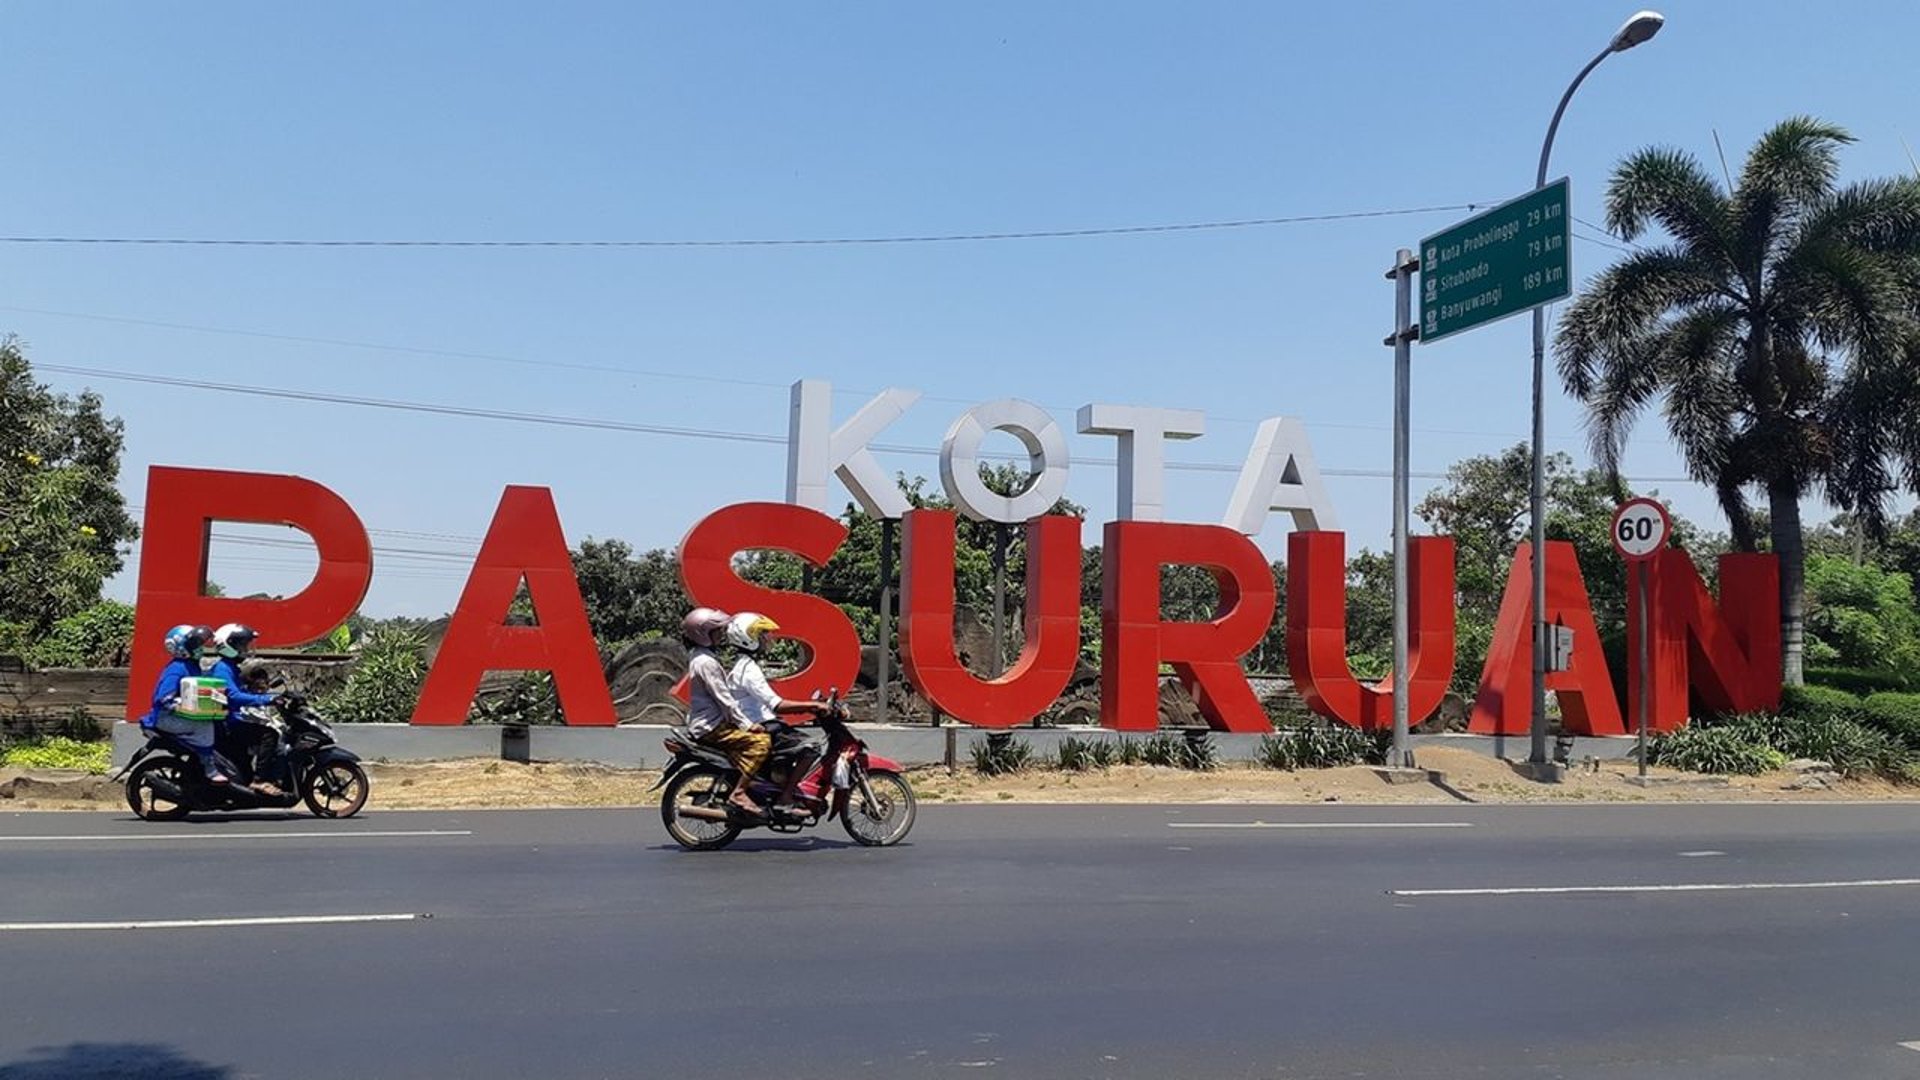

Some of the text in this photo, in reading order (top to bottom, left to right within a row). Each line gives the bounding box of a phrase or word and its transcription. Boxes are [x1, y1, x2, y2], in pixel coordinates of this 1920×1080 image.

[1441, 244, 1460, 262] Kota
[1464, 220, 1519, 252] Probolinggo
[1527, 211, 1540, 227] 29
[1544, 203, 1561, 218] km
[1441, 235, 1562, 290] Situbondo 79 km
[1441, 284, 1503, 319] Banyuwangi
[1523, 271, 1541, 290] 189
[1545, 267, 1562, 283] km
[786, 379, 1341, 536] KOTA
[1619, 517, 1652, 542] 60
[127, 465, 1781, 736] PASURUAN
